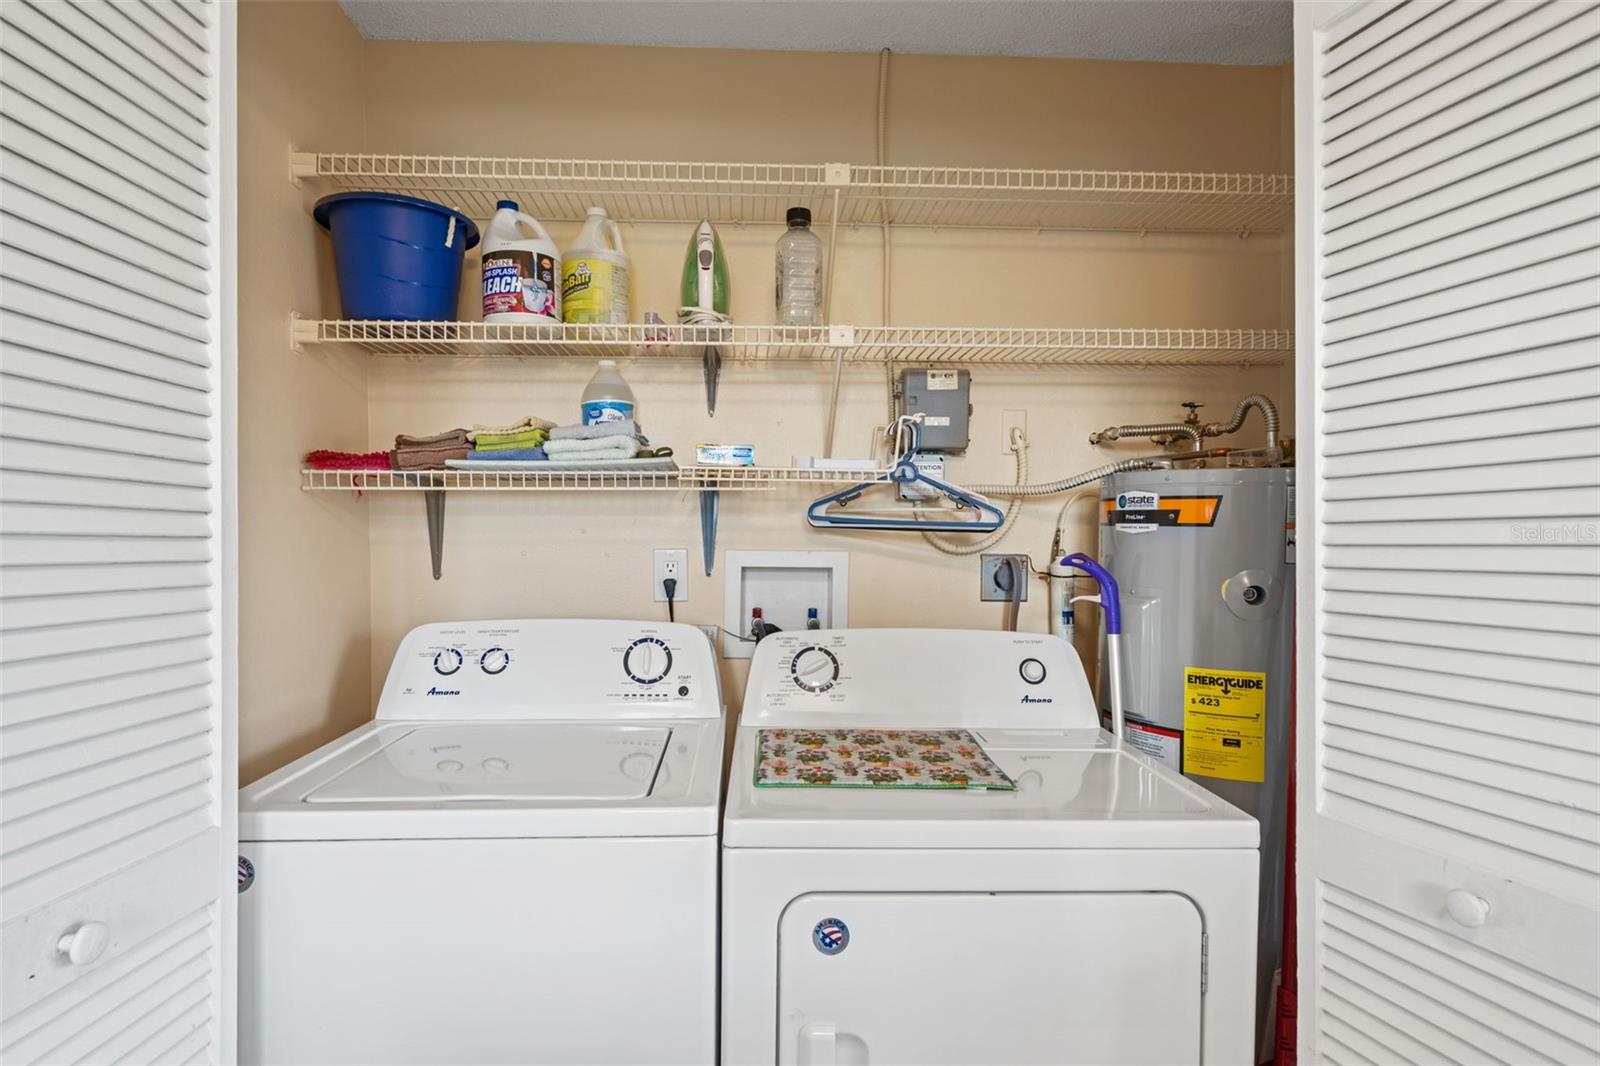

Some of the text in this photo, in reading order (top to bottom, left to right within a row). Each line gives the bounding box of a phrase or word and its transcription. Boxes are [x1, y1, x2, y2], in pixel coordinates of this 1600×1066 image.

[484, 276, 523, 296] LEACH
[1127, 495, 1155, 504] state
[1187, 674, 1263, 690] ENERGYGUIDE
[427, 687, 460, 697] Amana
[1021, 694, 1053, 704] Amana
[1198, 696, 1220, 707] 423
[815, 919, 846, 935] AMERICA
